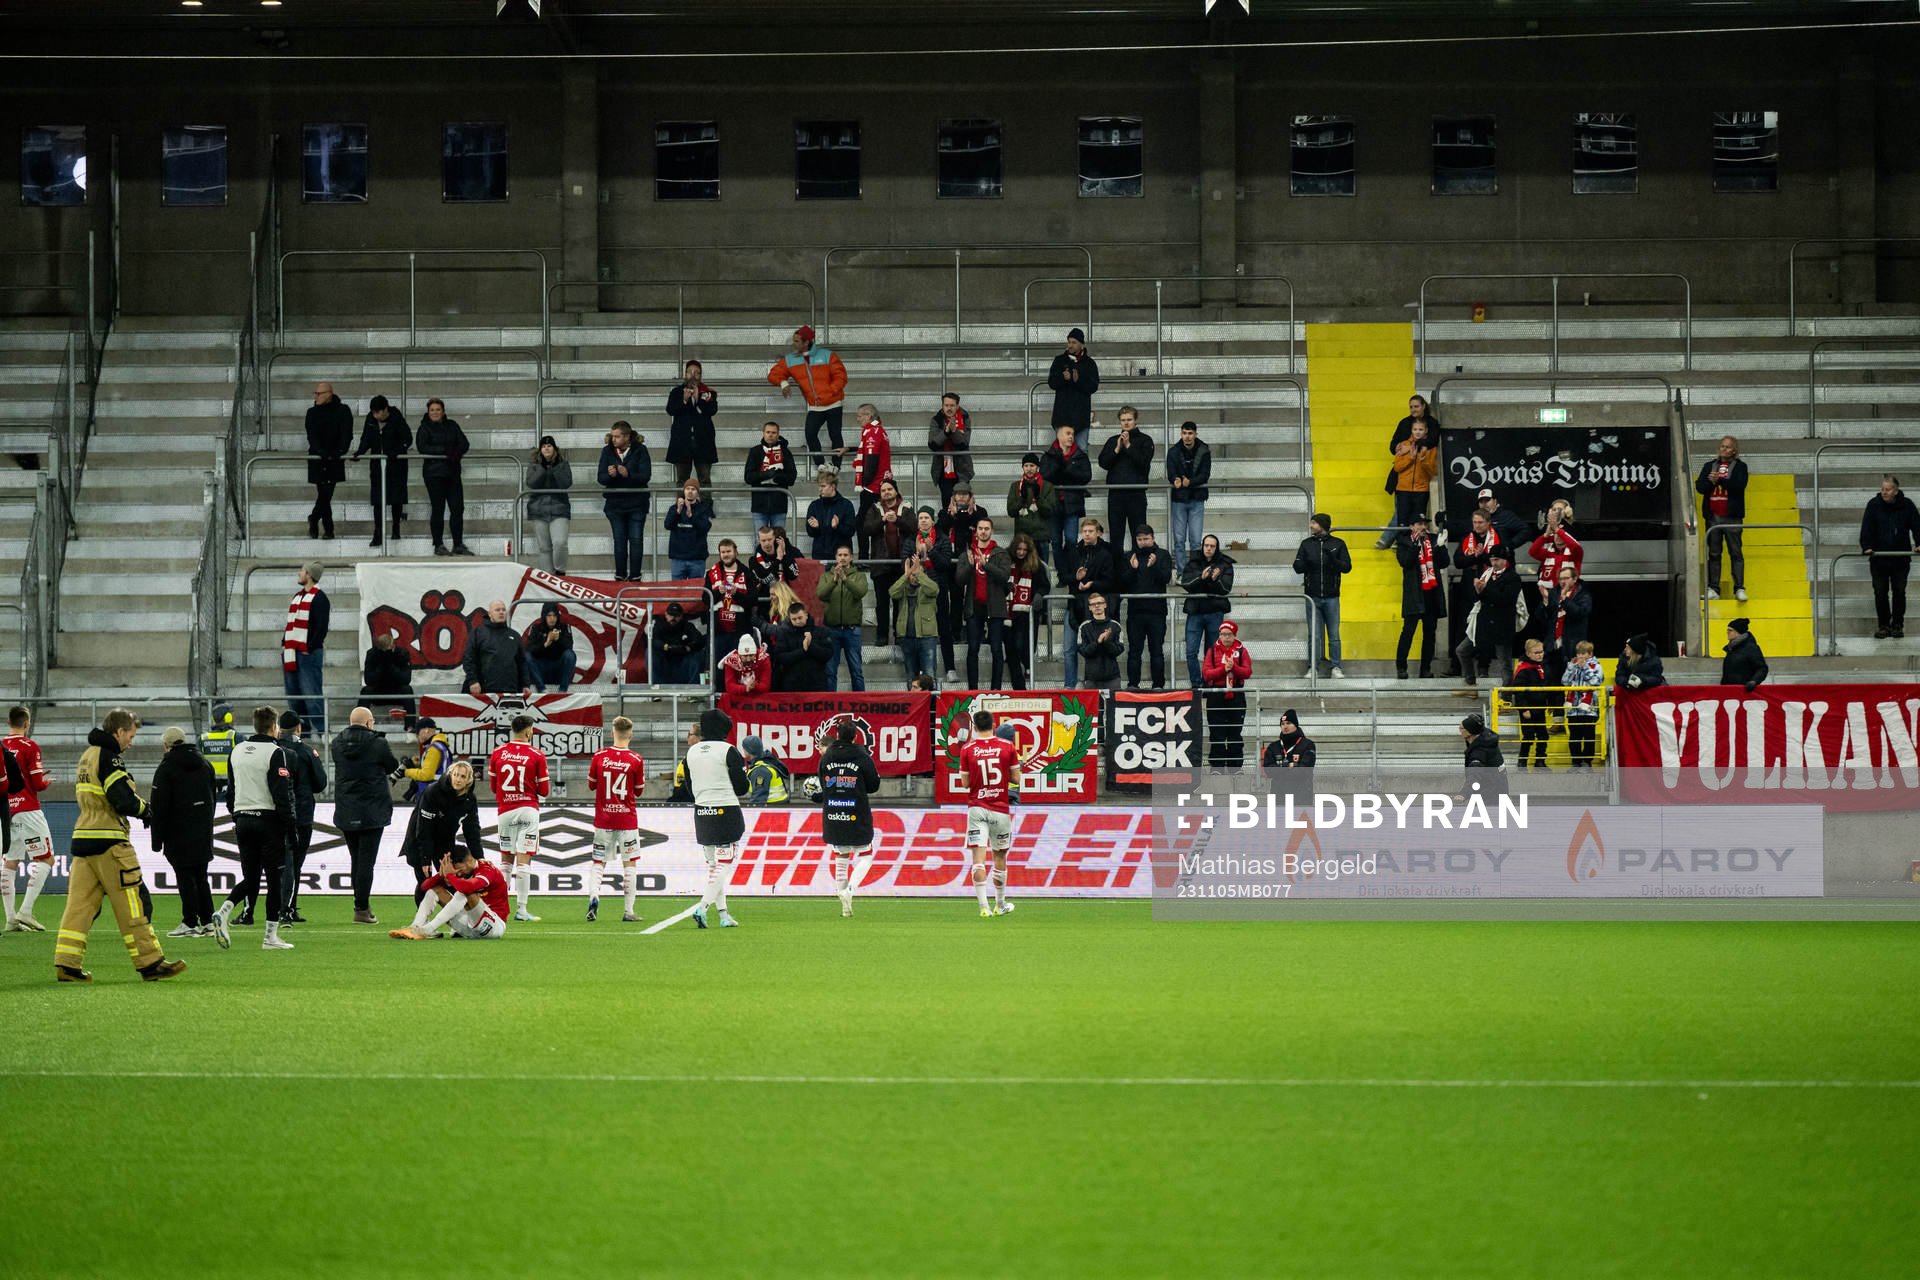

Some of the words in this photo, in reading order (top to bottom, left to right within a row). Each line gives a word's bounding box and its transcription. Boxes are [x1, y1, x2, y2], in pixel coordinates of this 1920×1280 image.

[1450, 456, 1543, 489] Borås
[1545, 455, 1661, 489] Tidning
[987, 701, 1047, 710] DEGERFORS
[582, 726, 602, 737] 2022
[1114, 705, 1192, 734] FCK
[880, 725, 917, 762] 03
[1114, 735, 1193, 769] ÖSK
[501, 764, 526, 792] 21
[978, 758, 1002, 786] 15
[603, 771, 627, 800] 14
[697, 806, 718, 816] askås
[828, 799, 855, 808] Helmia
[827, 812, 851, 821] askås
[1336, 848, 1513, 874] PAROY
[1618, 848, 1795, 872] PAROY
[1358, 884, 1379, 897] Din
[1383, 884, 1422, 897] lokala
[1425, 884, 1482, 897] drivkraft
[1641, 884, 1664, 897] Din
[1667, 884, 1707, 897] lokala
[1709, 884, 1765, 897] drivkraft
